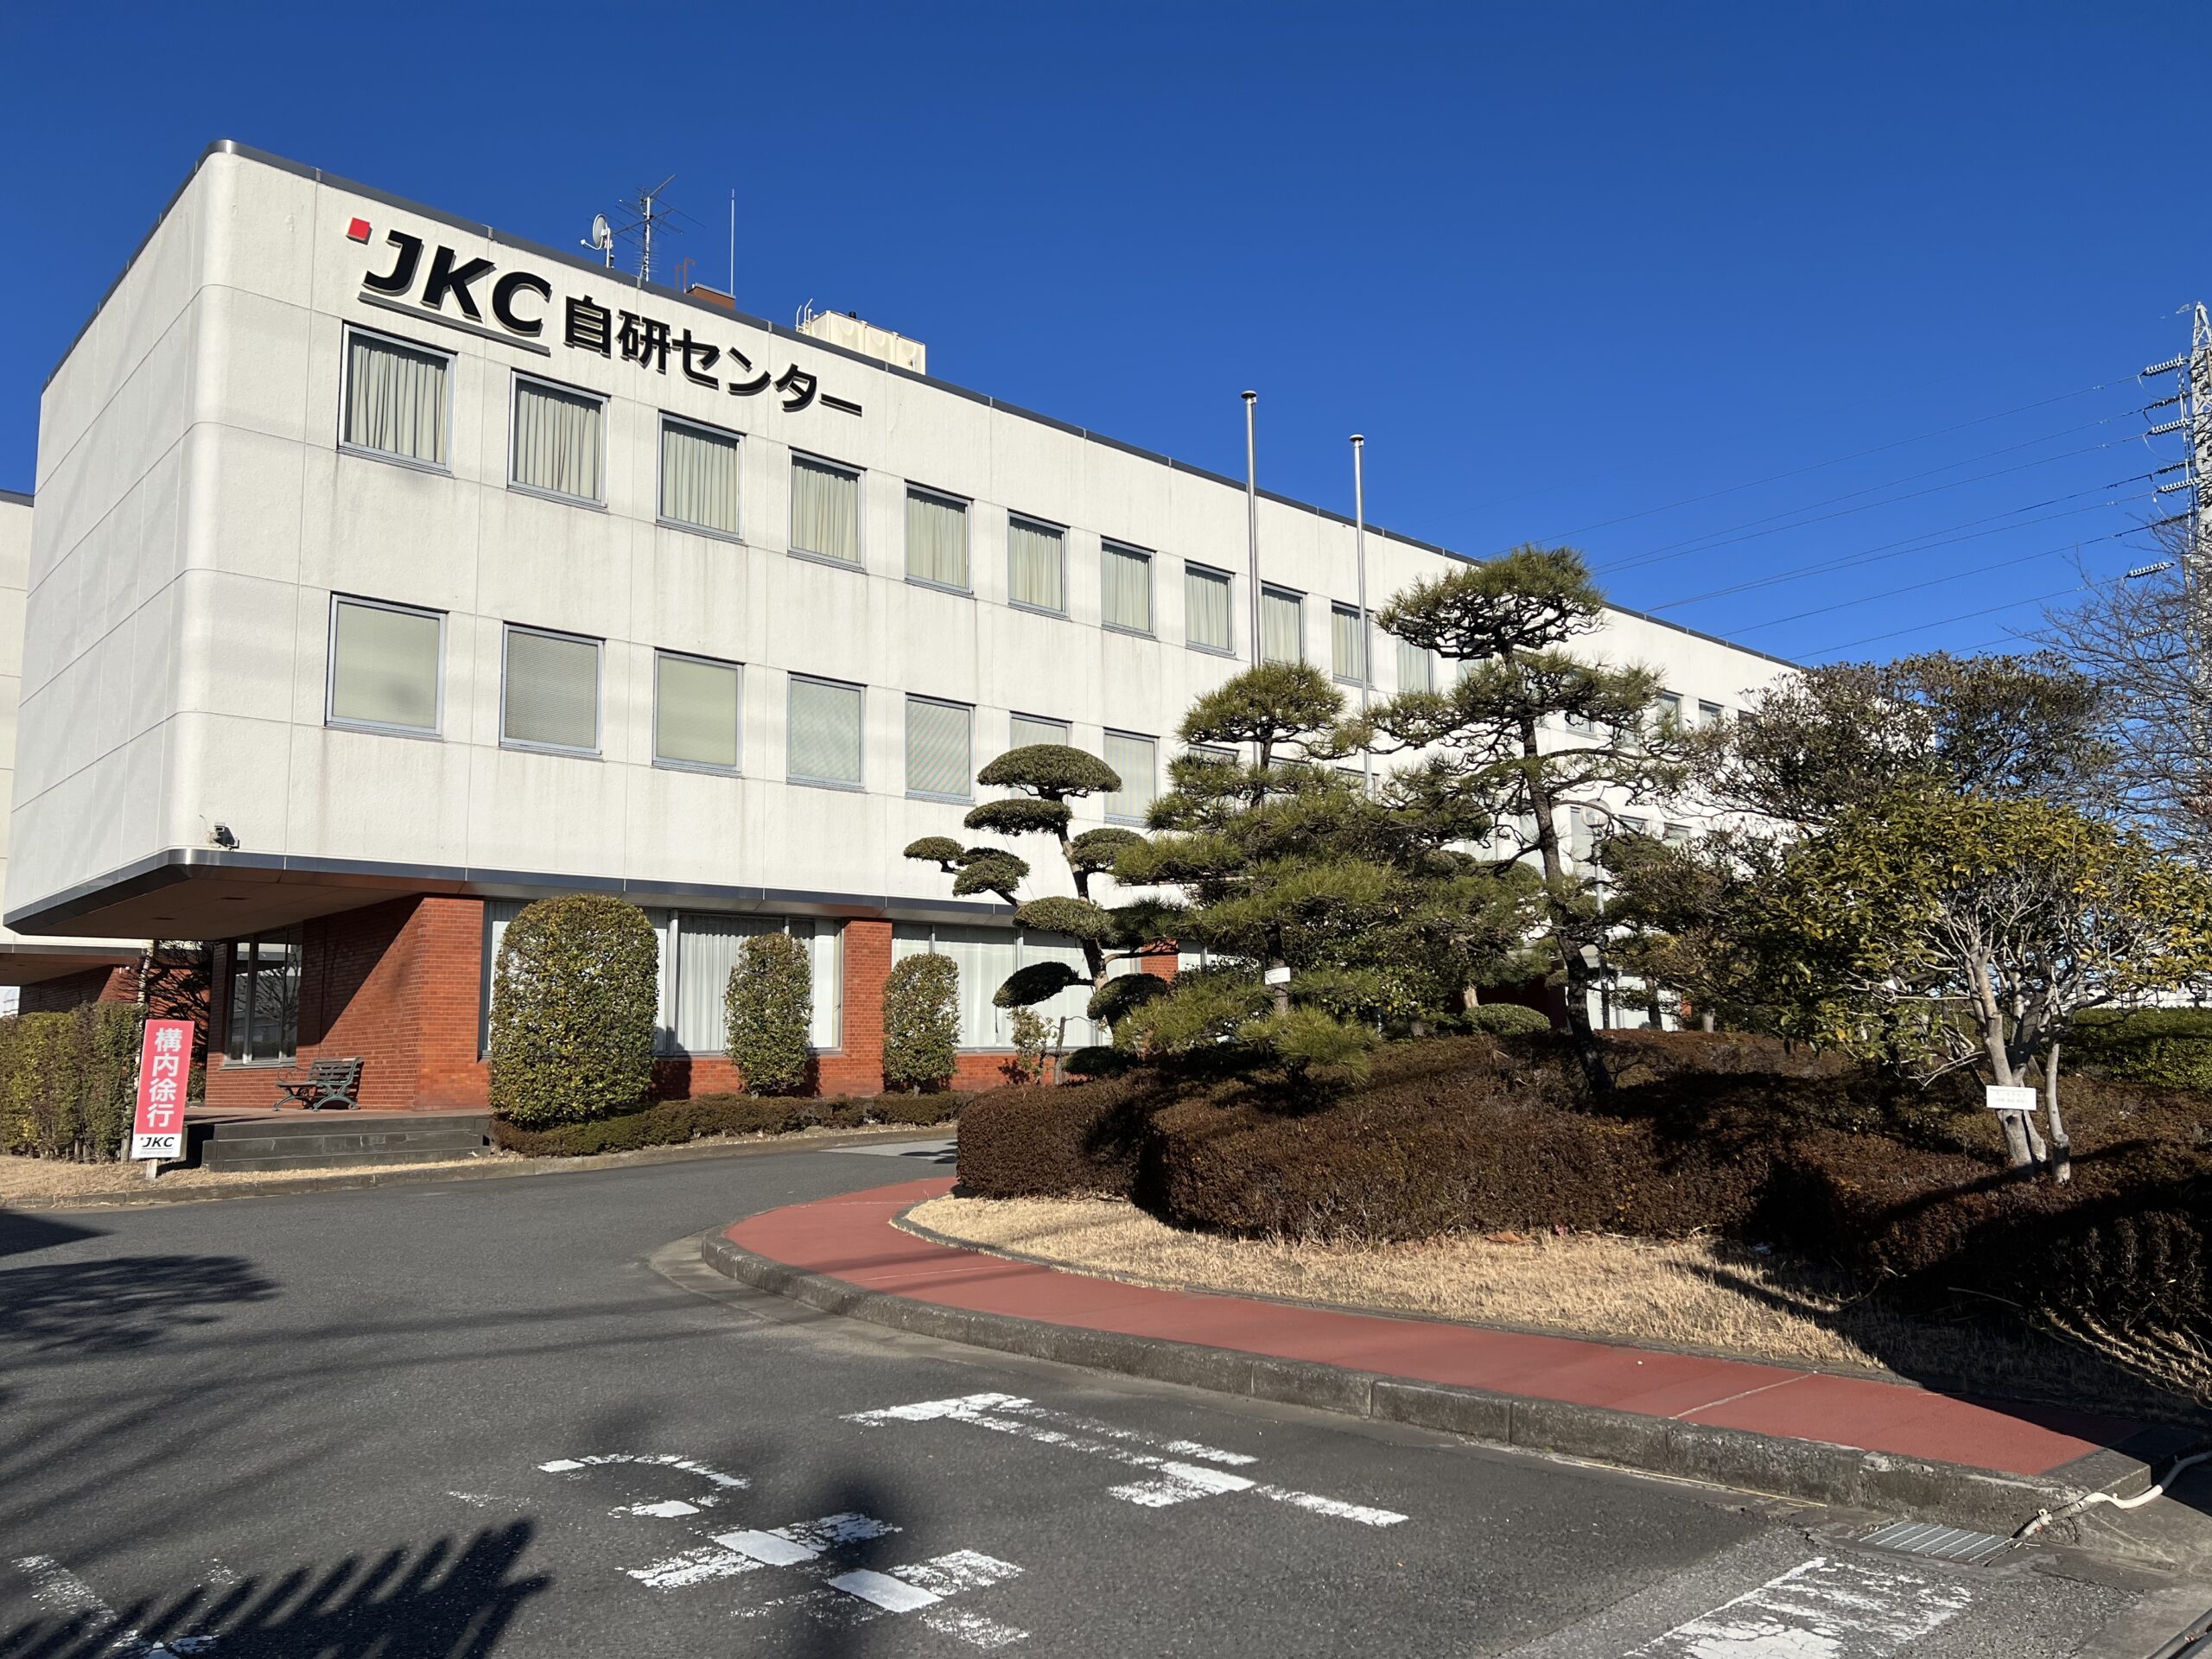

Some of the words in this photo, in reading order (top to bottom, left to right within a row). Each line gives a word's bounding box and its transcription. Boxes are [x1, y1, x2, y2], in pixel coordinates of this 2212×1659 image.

[362, 229, 551, 336] JKC
[564, 295, 863, 417] 自研センター
[147, 1027, 182, 1128] 構内徐行
[142, 1136, 175, 1147] JKC
